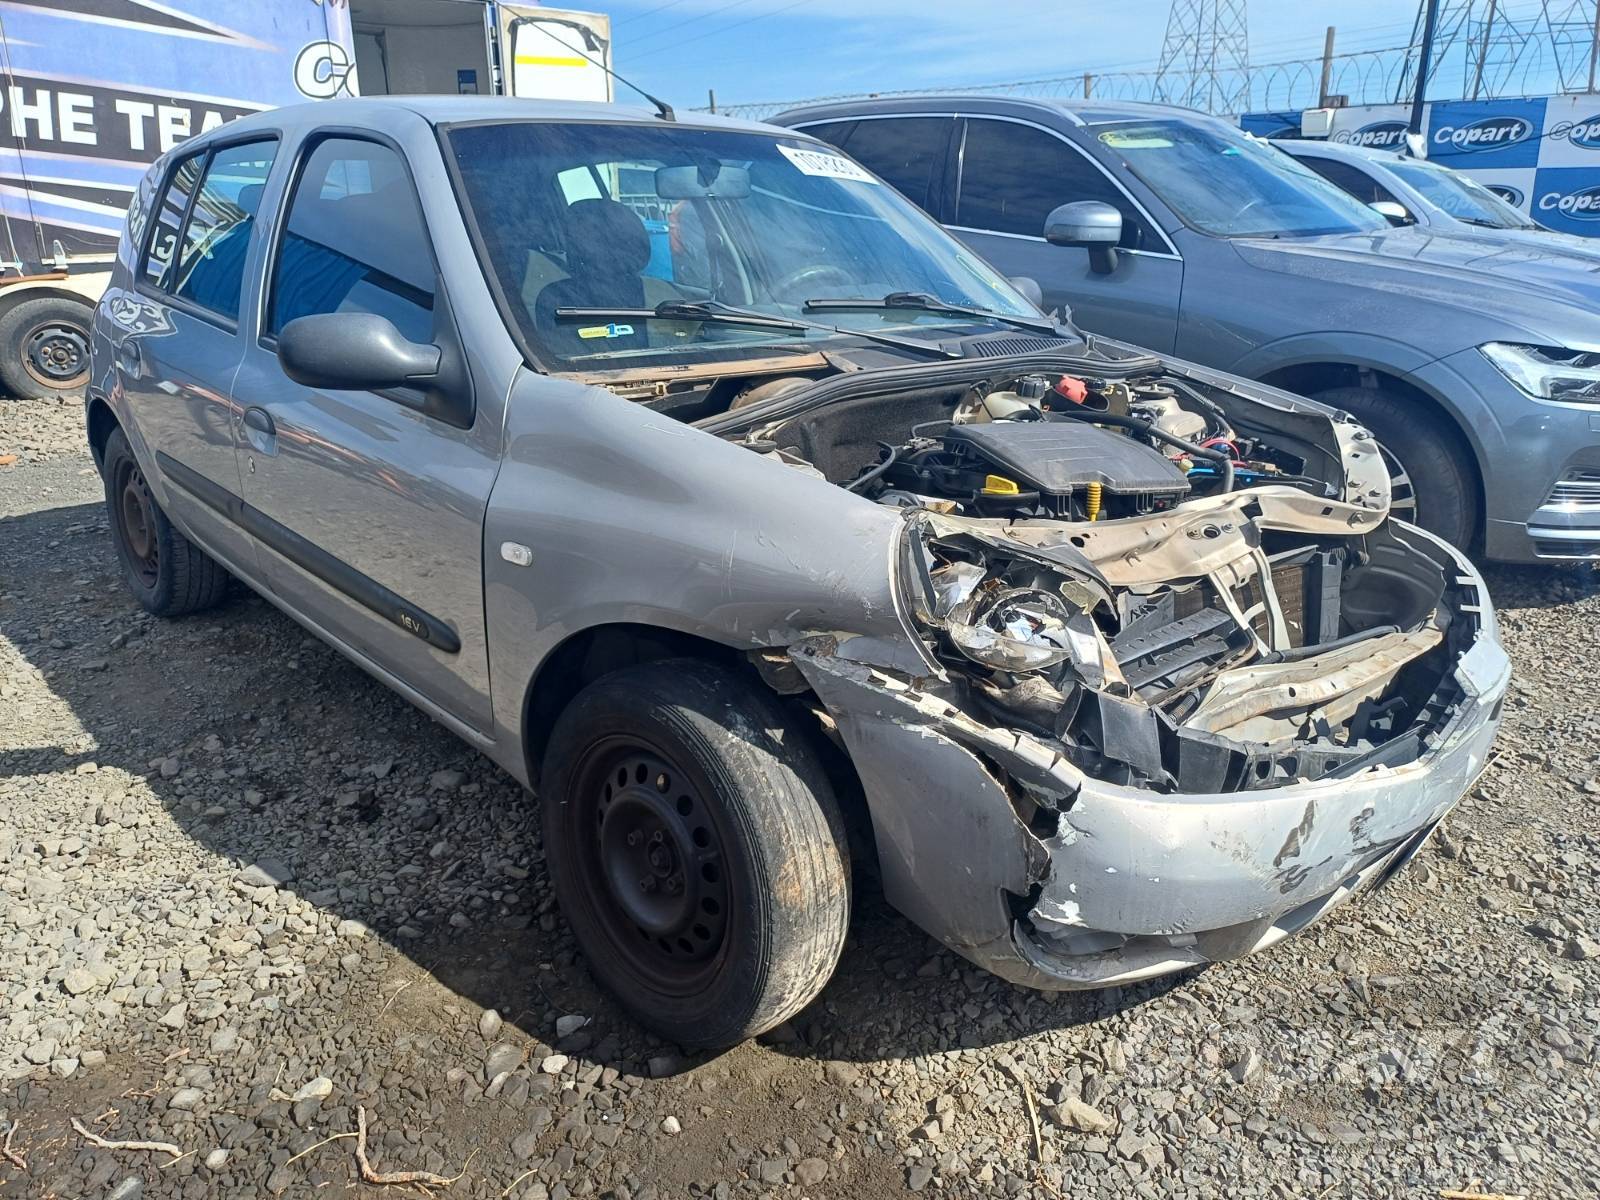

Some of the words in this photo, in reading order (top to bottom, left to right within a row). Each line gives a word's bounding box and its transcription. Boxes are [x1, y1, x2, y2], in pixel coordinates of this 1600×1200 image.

[0, 86, 98, 145] HE
[115, 99, 246, 152] TE
[1434, 122, 1521, 146] Copart
[401, 614, 420, 633] 16V
